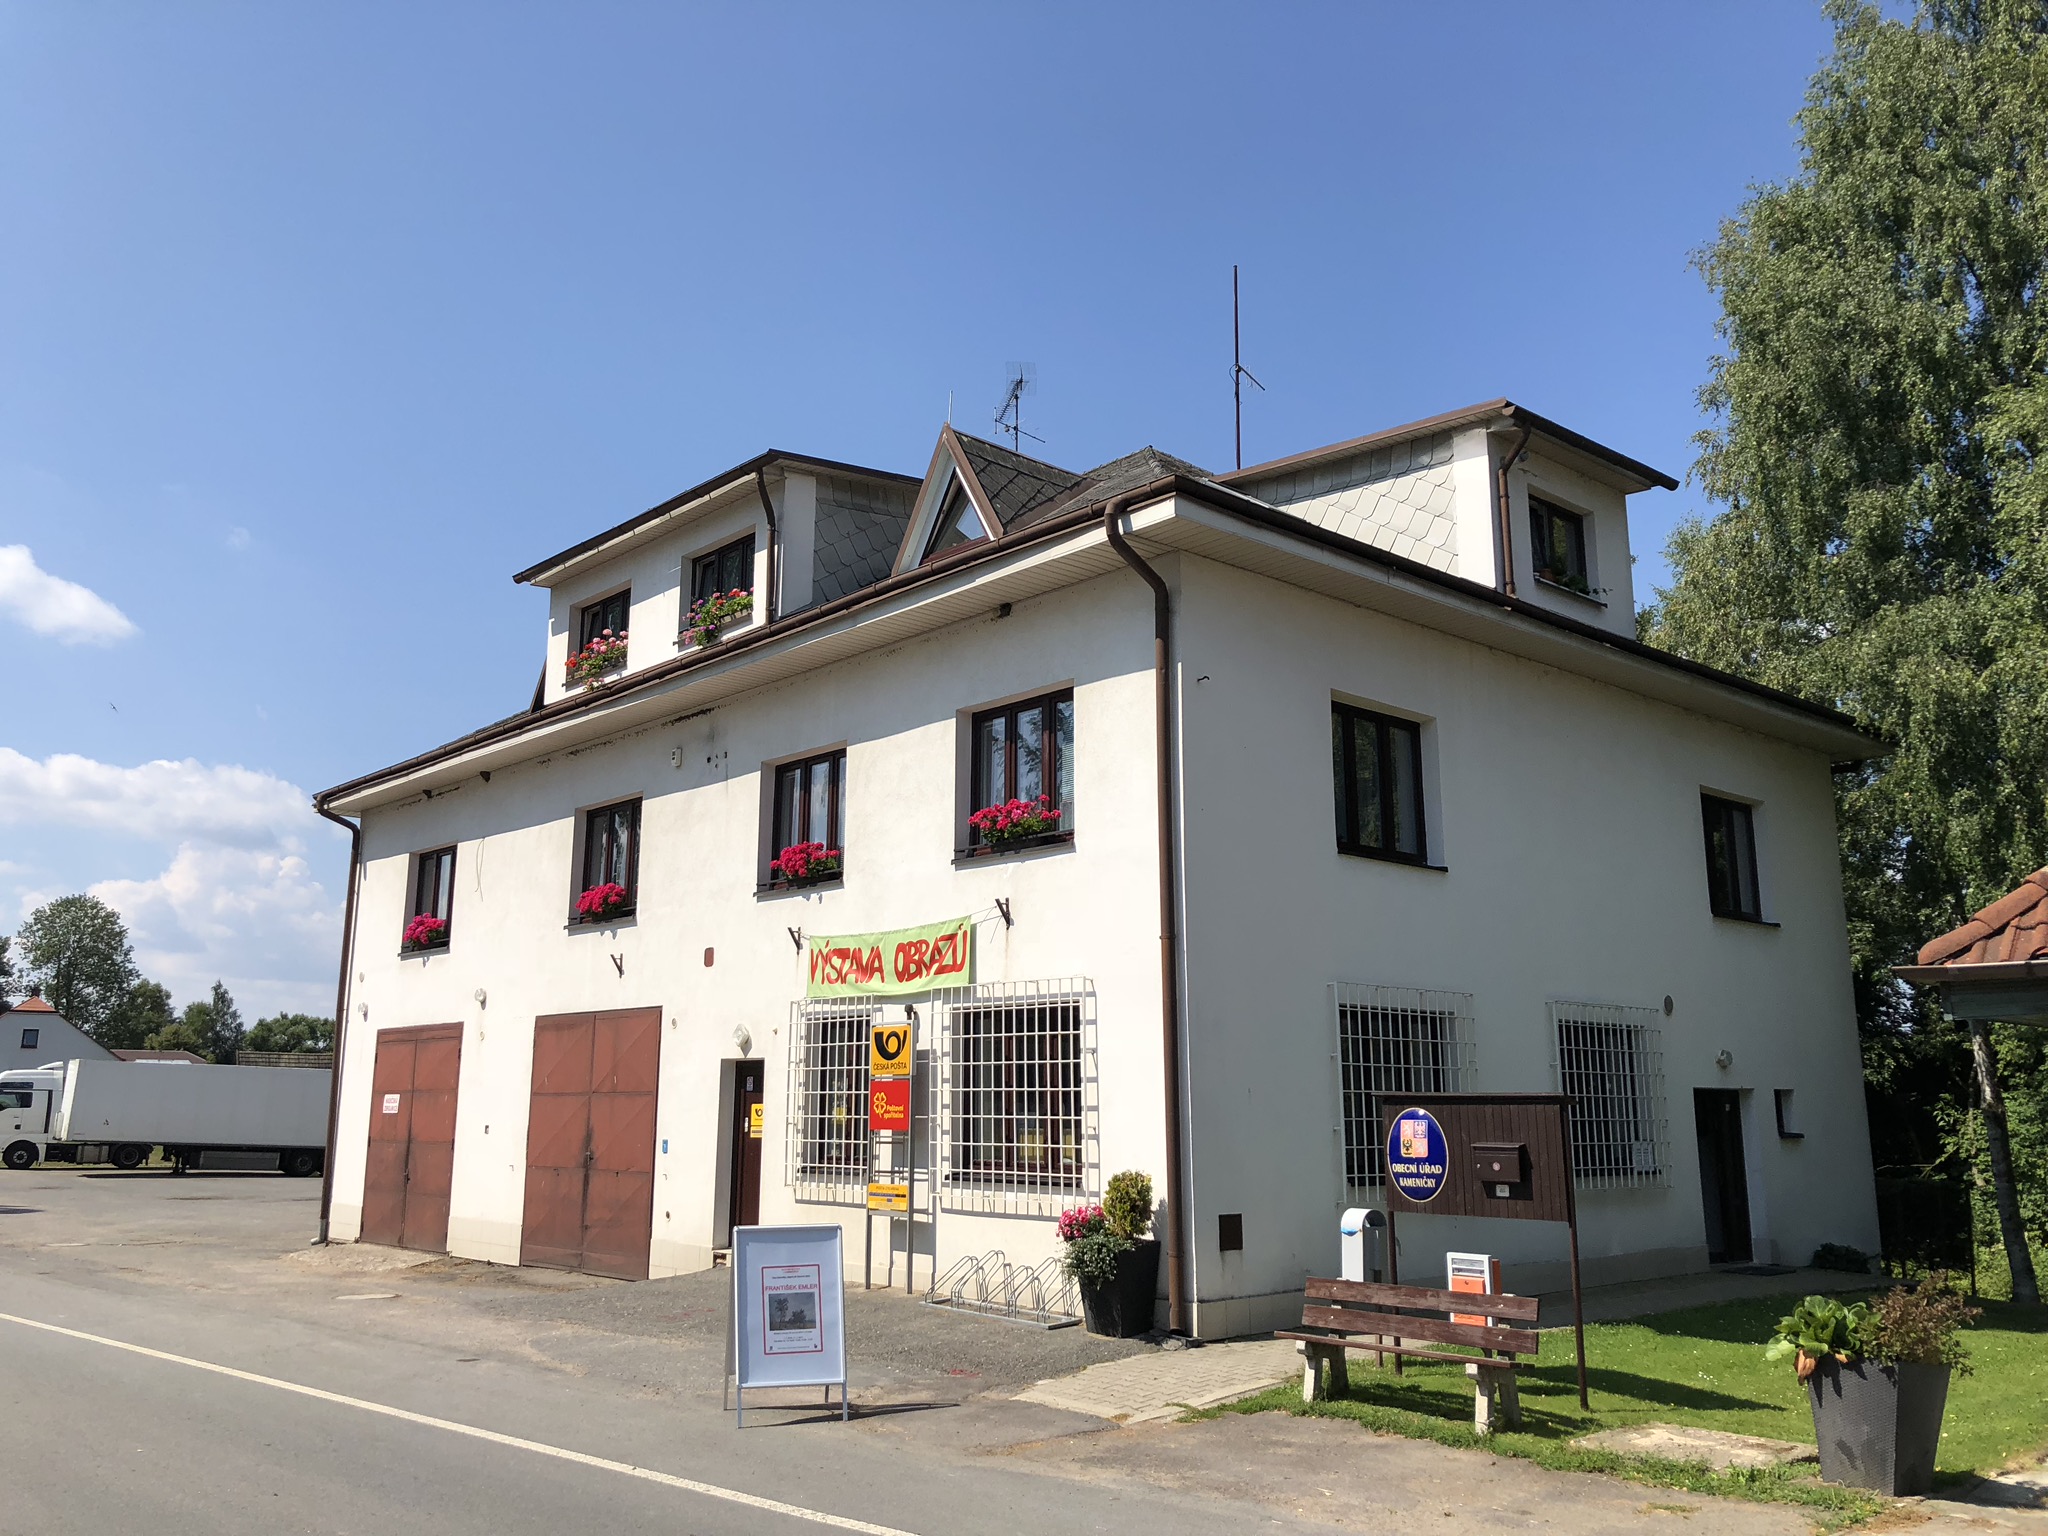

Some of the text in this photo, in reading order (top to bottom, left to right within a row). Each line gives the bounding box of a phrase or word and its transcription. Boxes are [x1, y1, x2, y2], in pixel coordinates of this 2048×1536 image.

[810, 923, 968, 985] VÝSTAVA OBRAZŮ
[873, 1061, 907, 1071] ČESKÁ POŠTA
[1392, 1162, 1443, 1174] OBECNÍ ÚŘAD
[1399, 1176, 1436, 1188] KAMENIČKY
